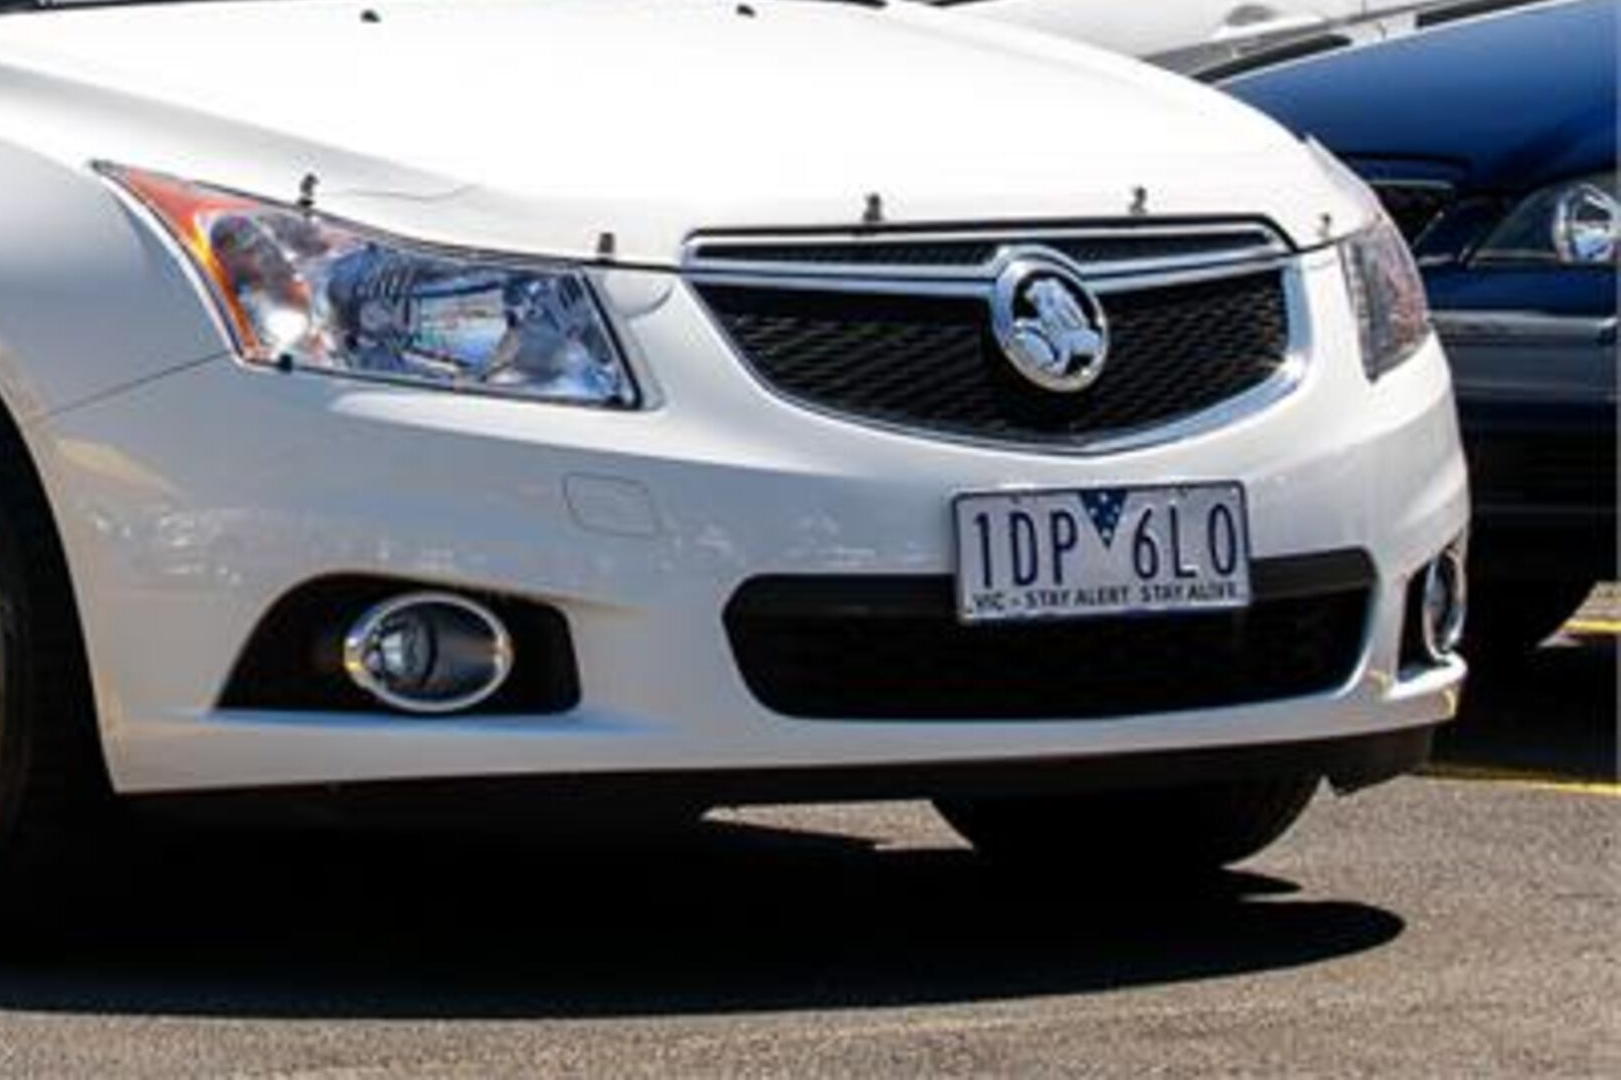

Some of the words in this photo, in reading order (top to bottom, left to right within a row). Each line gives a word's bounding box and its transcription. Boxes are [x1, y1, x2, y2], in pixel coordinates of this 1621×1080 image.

[973, 509, 1078, 588] 1DP
[1024, 588, 1071, 609] STAY
[1074, 586, 1129, 606] ALERT
[1140, 582, 1183, 604] STAY
